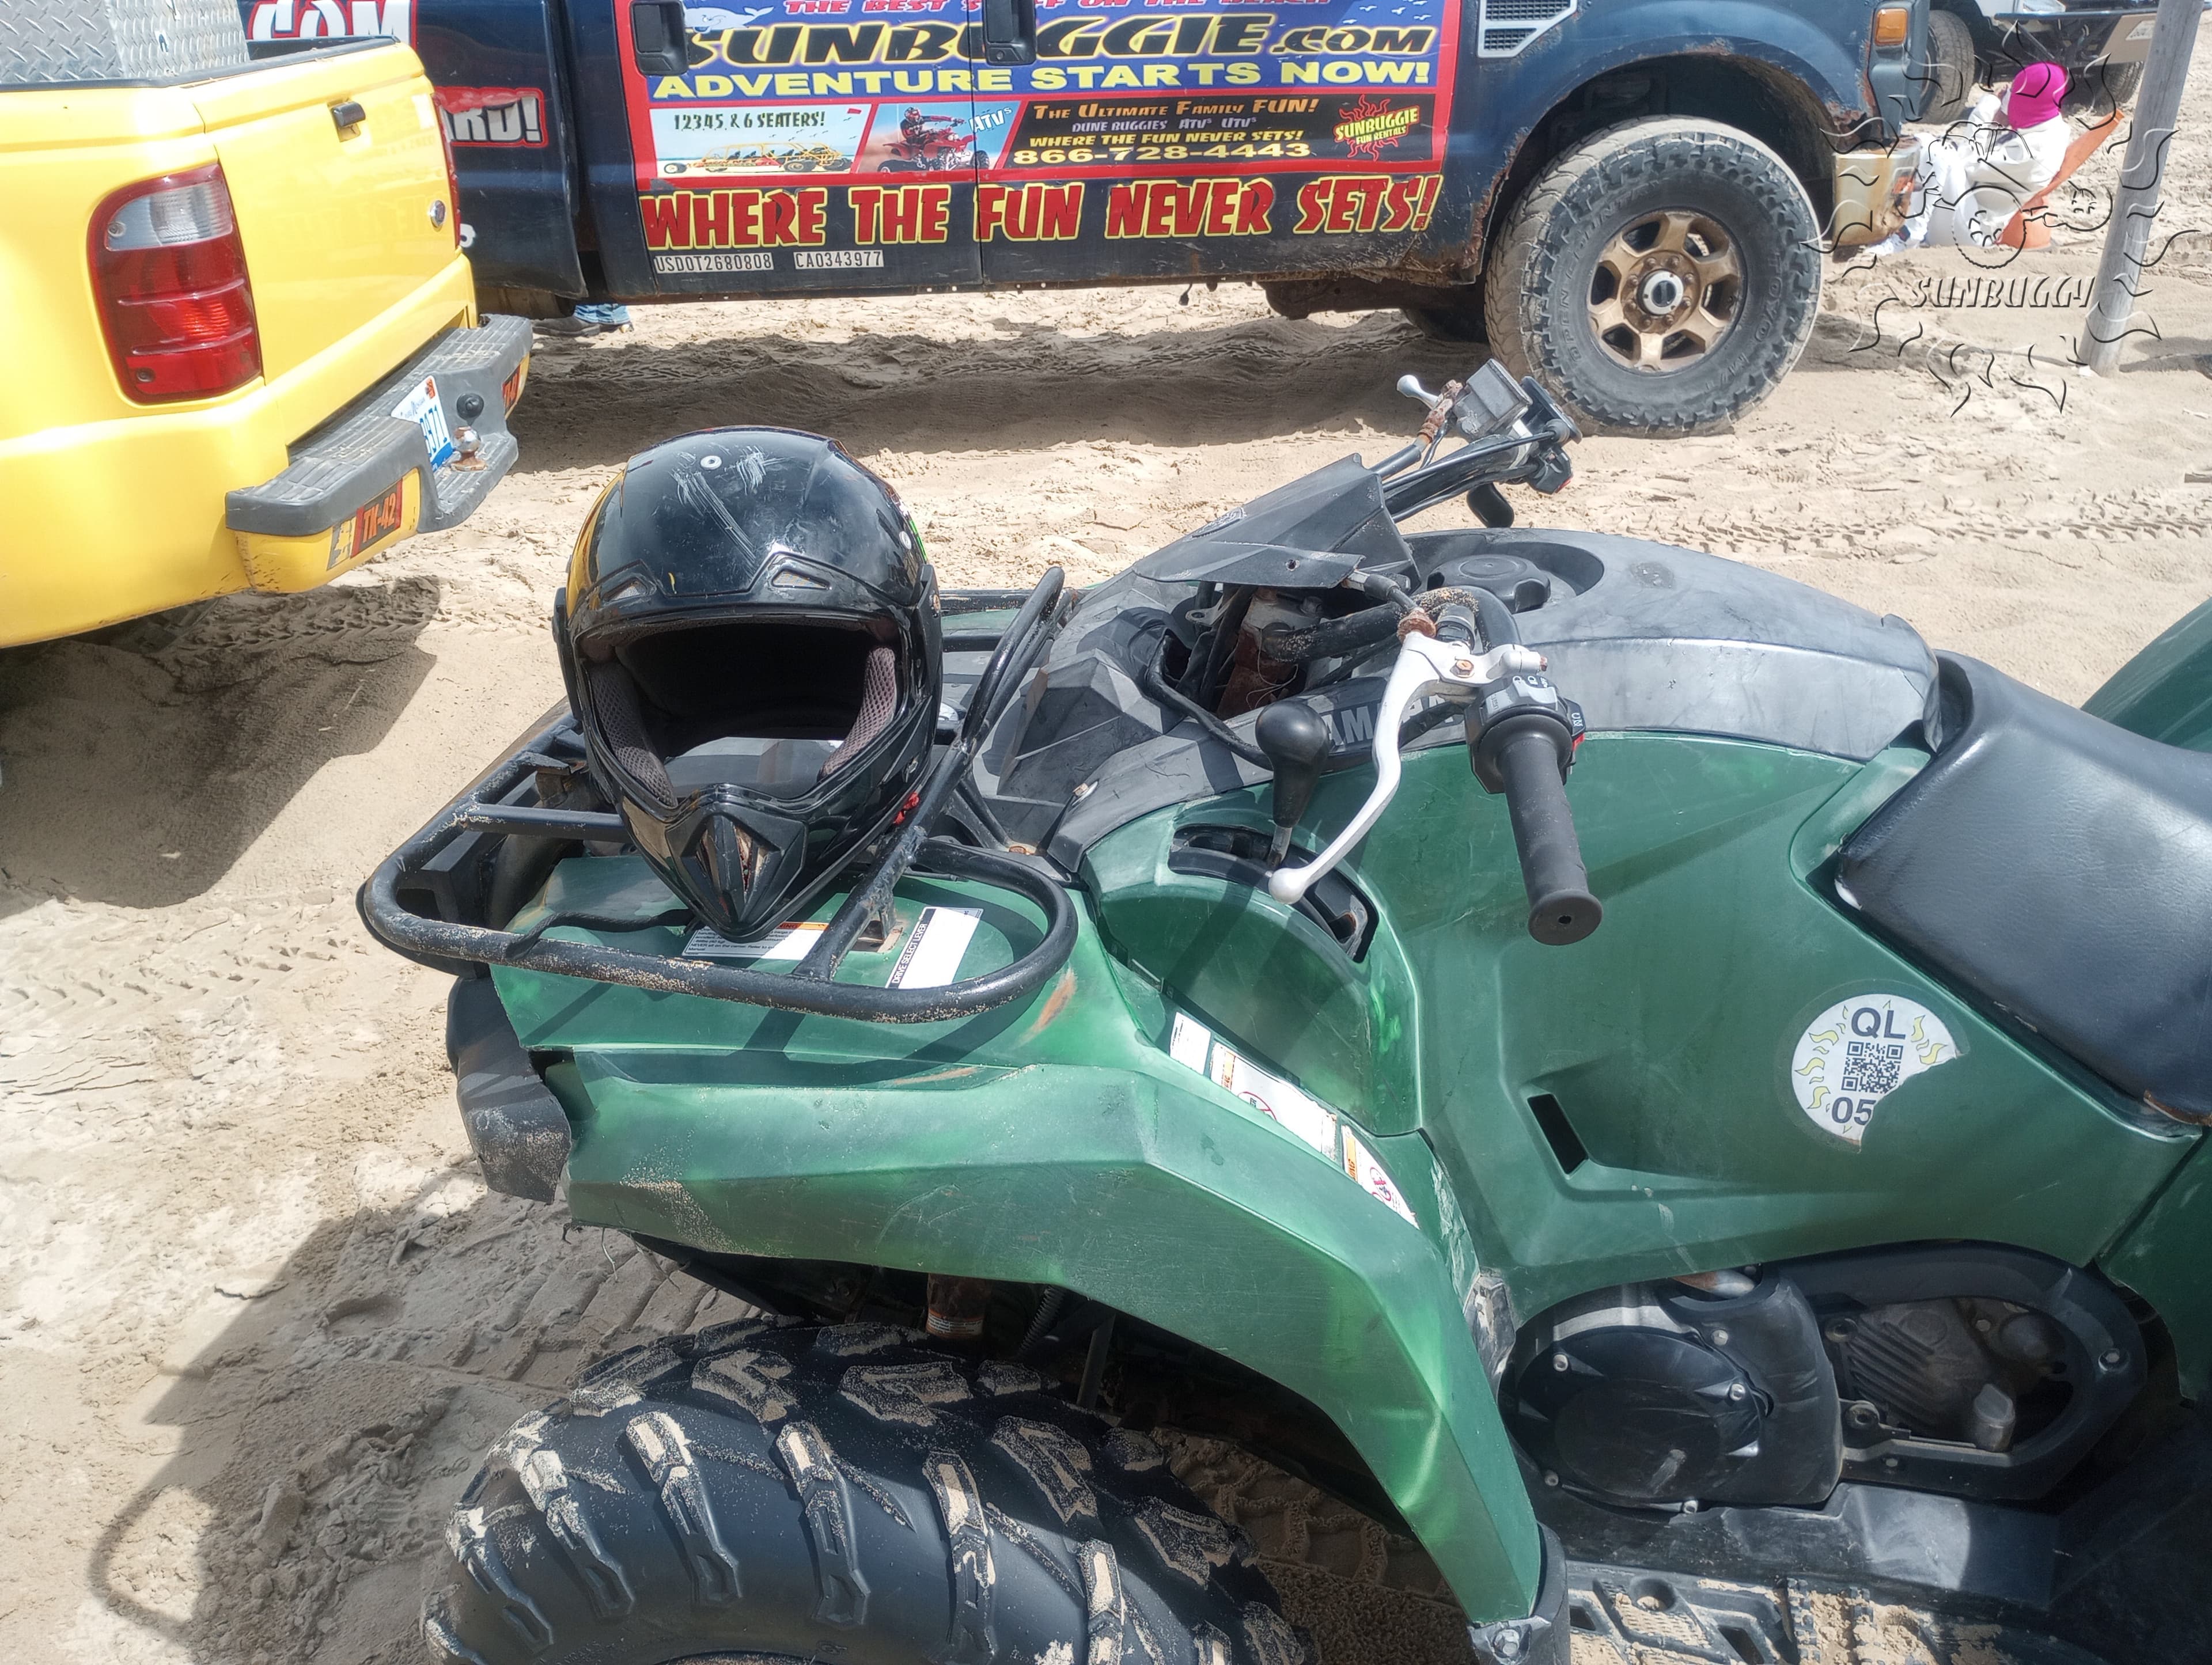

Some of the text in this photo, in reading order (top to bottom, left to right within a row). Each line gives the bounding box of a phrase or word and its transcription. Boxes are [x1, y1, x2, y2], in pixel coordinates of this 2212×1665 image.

[785, 1, 850, 13] THE
[653, 60, 1430, 98] ADVENTURE STARTS NOW!
[1252, 98, 1320, 113] FUN!
[730, 113, 740, 128] &
[744, 113, 752, 128] 6
[757, 111, 825, 128] SEATERS!
[1072, 122, 1107, 132] DUNE
[1111, 120, 1168, 131] BUGGIES
[1335, 108, 1418, 141] SUNBUGGIE
[1030, 130, 1304, 147] WHERE THE FUN NEVER SETS!
[1356, 126, 1407, 145] FUN RENTALS
[1013, 142, 1310, 164] 866-728-4443
[640, 175, 1442, 249] WHERE THE FUN NEVER SETS!
[656, 252, 882, 272] USDOT2680808 CA0343977
[892, 924, 927, 983] DRIVE SELECT LEVER
[1851, 1007, 1906, 1040] QL
[1832, 1097, 1877, 1126] 05
